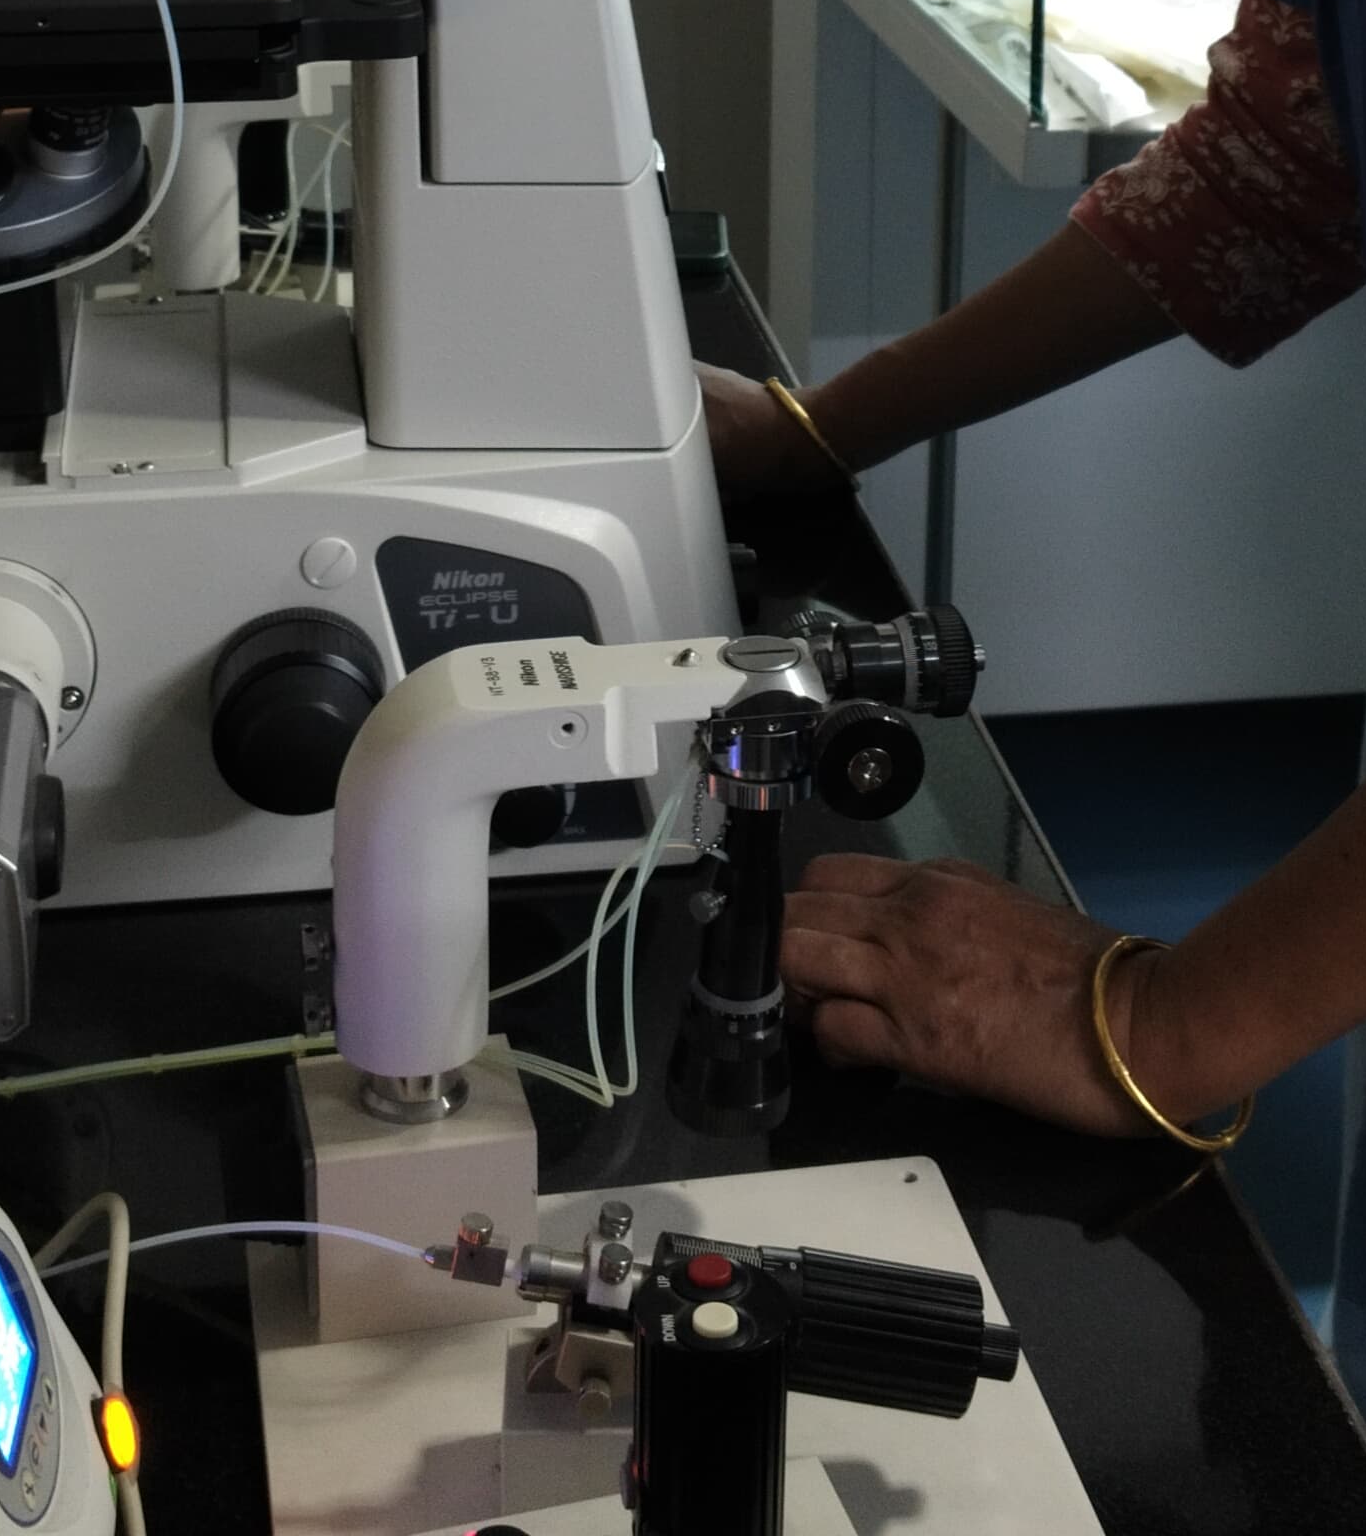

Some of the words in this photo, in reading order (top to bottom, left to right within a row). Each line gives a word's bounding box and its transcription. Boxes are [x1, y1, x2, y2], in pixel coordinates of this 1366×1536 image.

[432, 570, 505, 590] Nikon
[419, 590, 519, 606] ECLIPSE
[519, 659, 540, 687] Nikon
[657, 1275, 670, 1288] UP
[661, 1314, 677, 1342] DOWN
